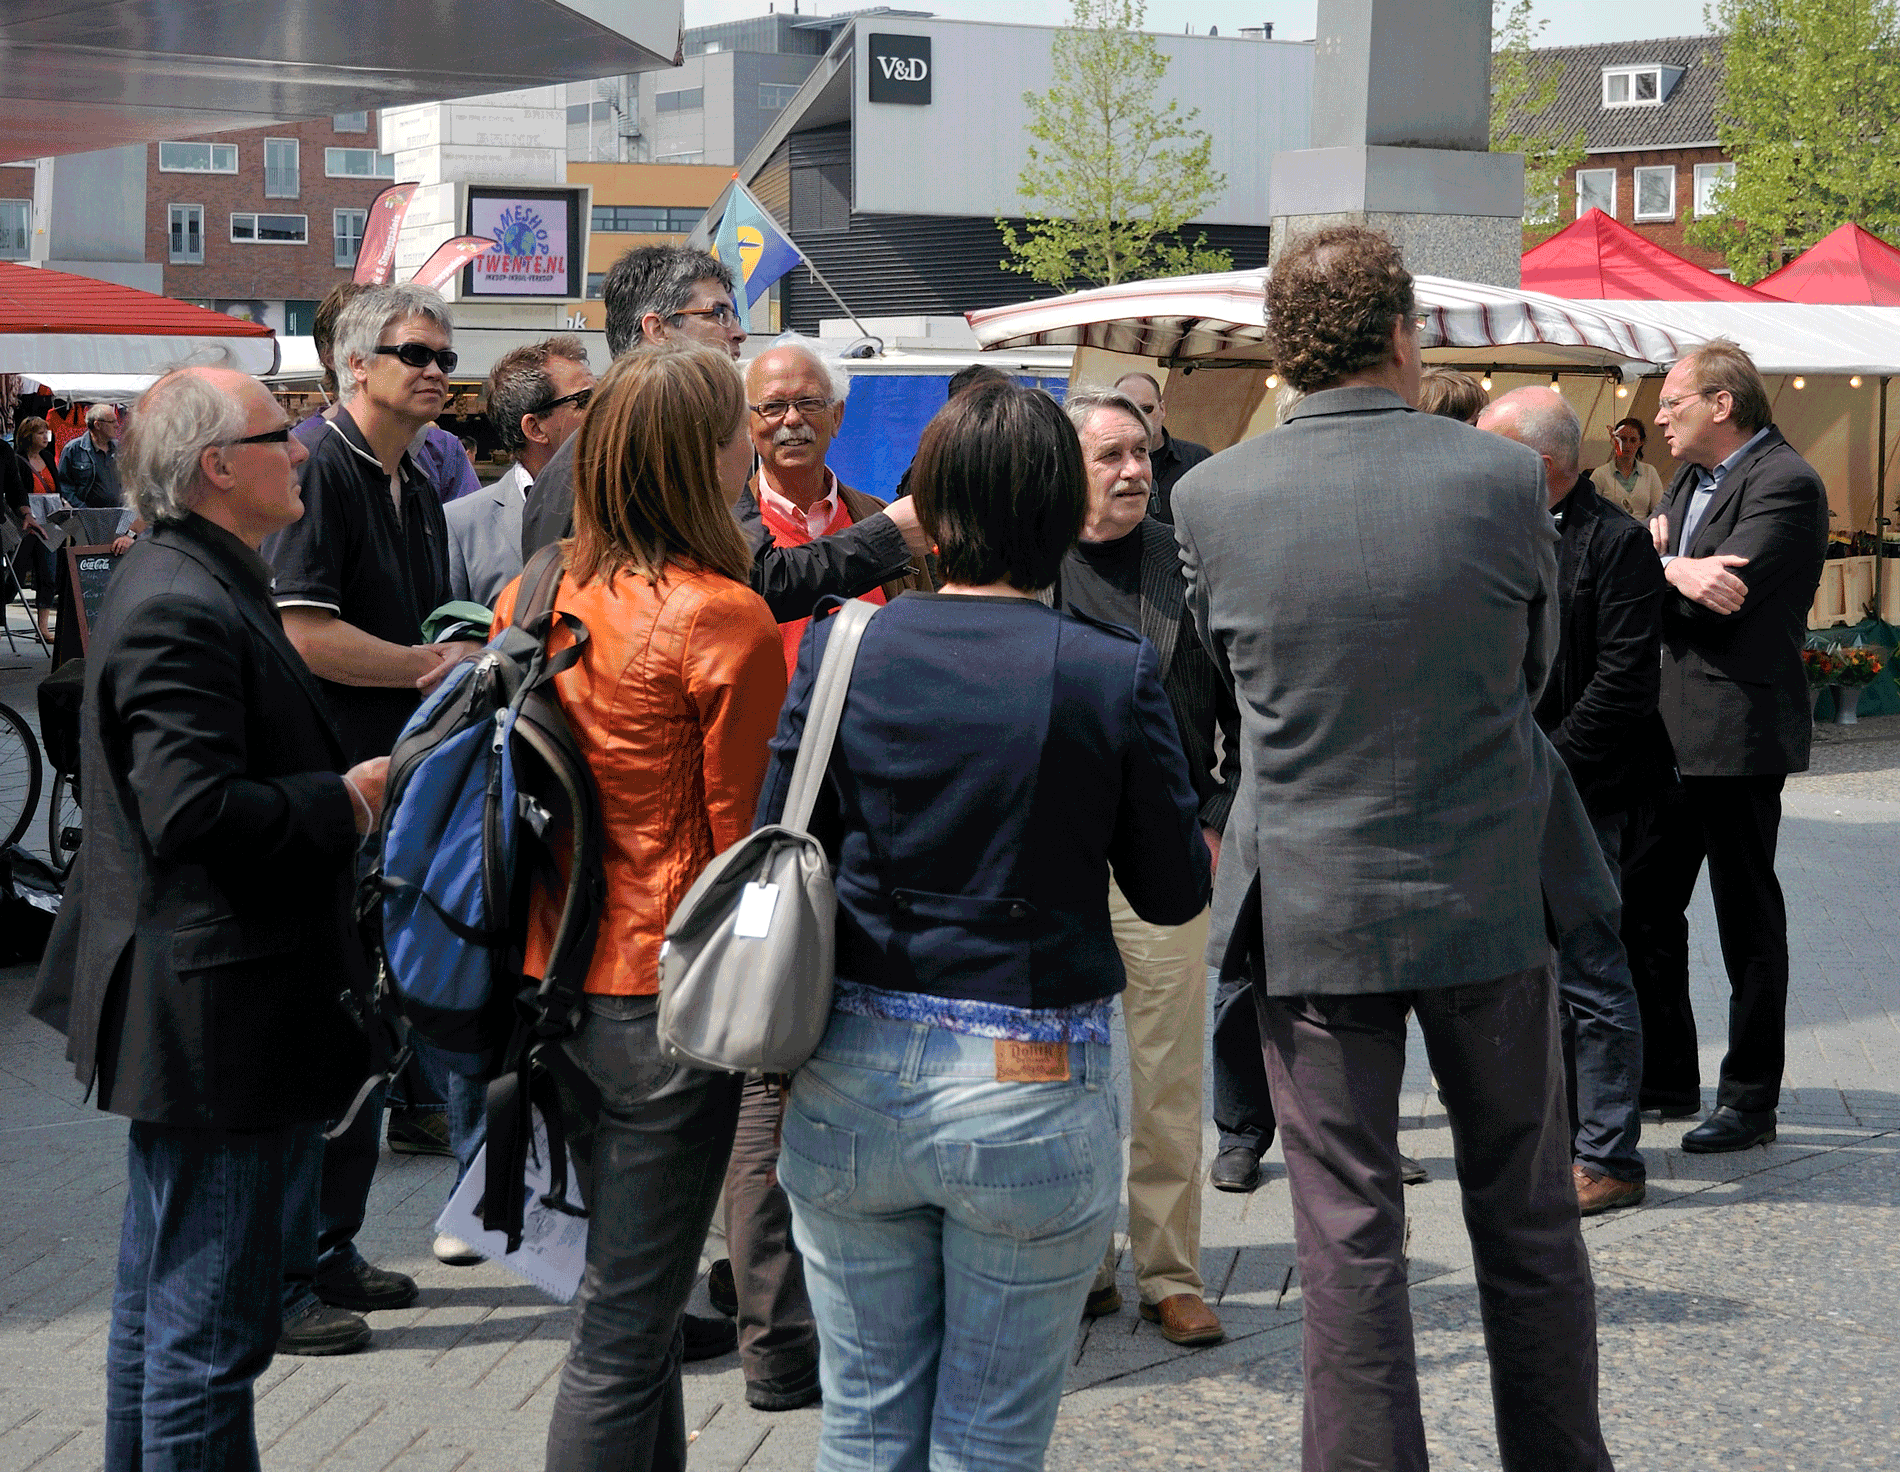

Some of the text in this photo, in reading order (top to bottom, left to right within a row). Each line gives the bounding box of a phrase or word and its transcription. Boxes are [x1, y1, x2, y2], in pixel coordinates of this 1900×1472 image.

[876, 56, 928, 81] V&D
[490, 204, 549, 255] GAMESHOP
[476, 254, 565, 274] TWENTE.NL
